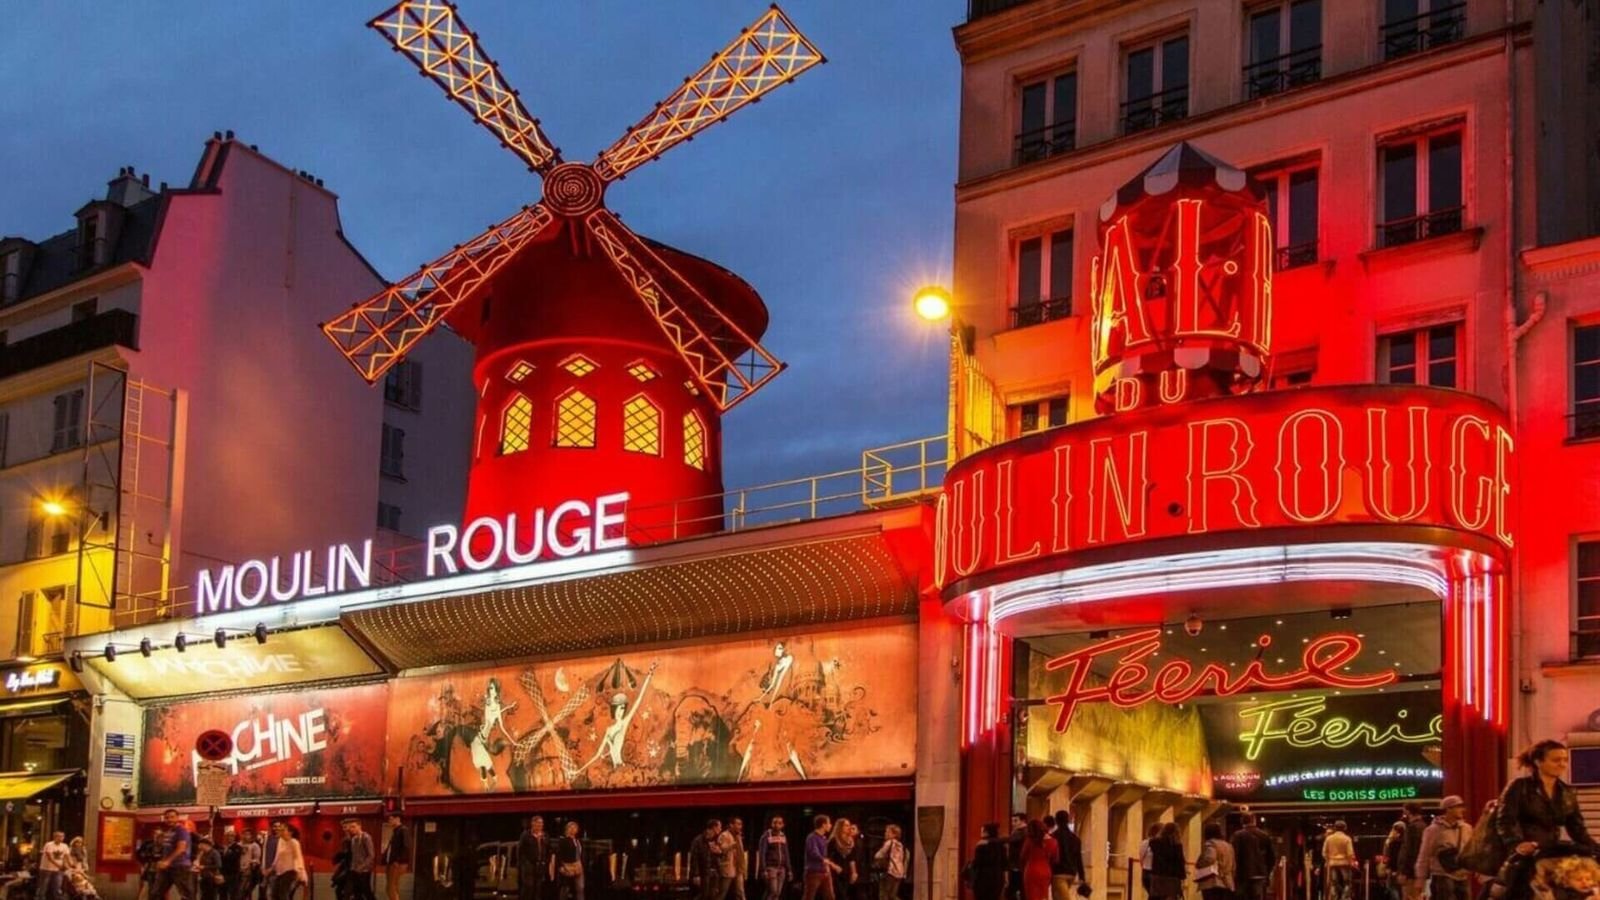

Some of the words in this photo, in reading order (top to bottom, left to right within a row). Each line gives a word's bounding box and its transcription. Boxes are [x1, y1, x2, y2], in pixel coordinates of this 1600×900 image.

[1115, 368, 1186, 412] DU
[934, 430, 1149, 590] OULIN
[1186, 407, 1514, 548] ROUGE
[196, 538, 373, 613] MOULIN
[425, 492, 630, 577] ROUGE
[1046, 629, 1396, 734] Féerie
[1265, 776, 1277, 787] LE
[1278, 774, 1300, 784] PLUS
[1375, 767, 1394, 776] CAN
[1396, 767, 1414, 776] CAN
[1415, 768, 1429, 777] DU
[1304, 790, 1326, 800] LES
[1329, 790, 1376, 801] DORISS
[1379, 787, 1416, 799] GIRLS
